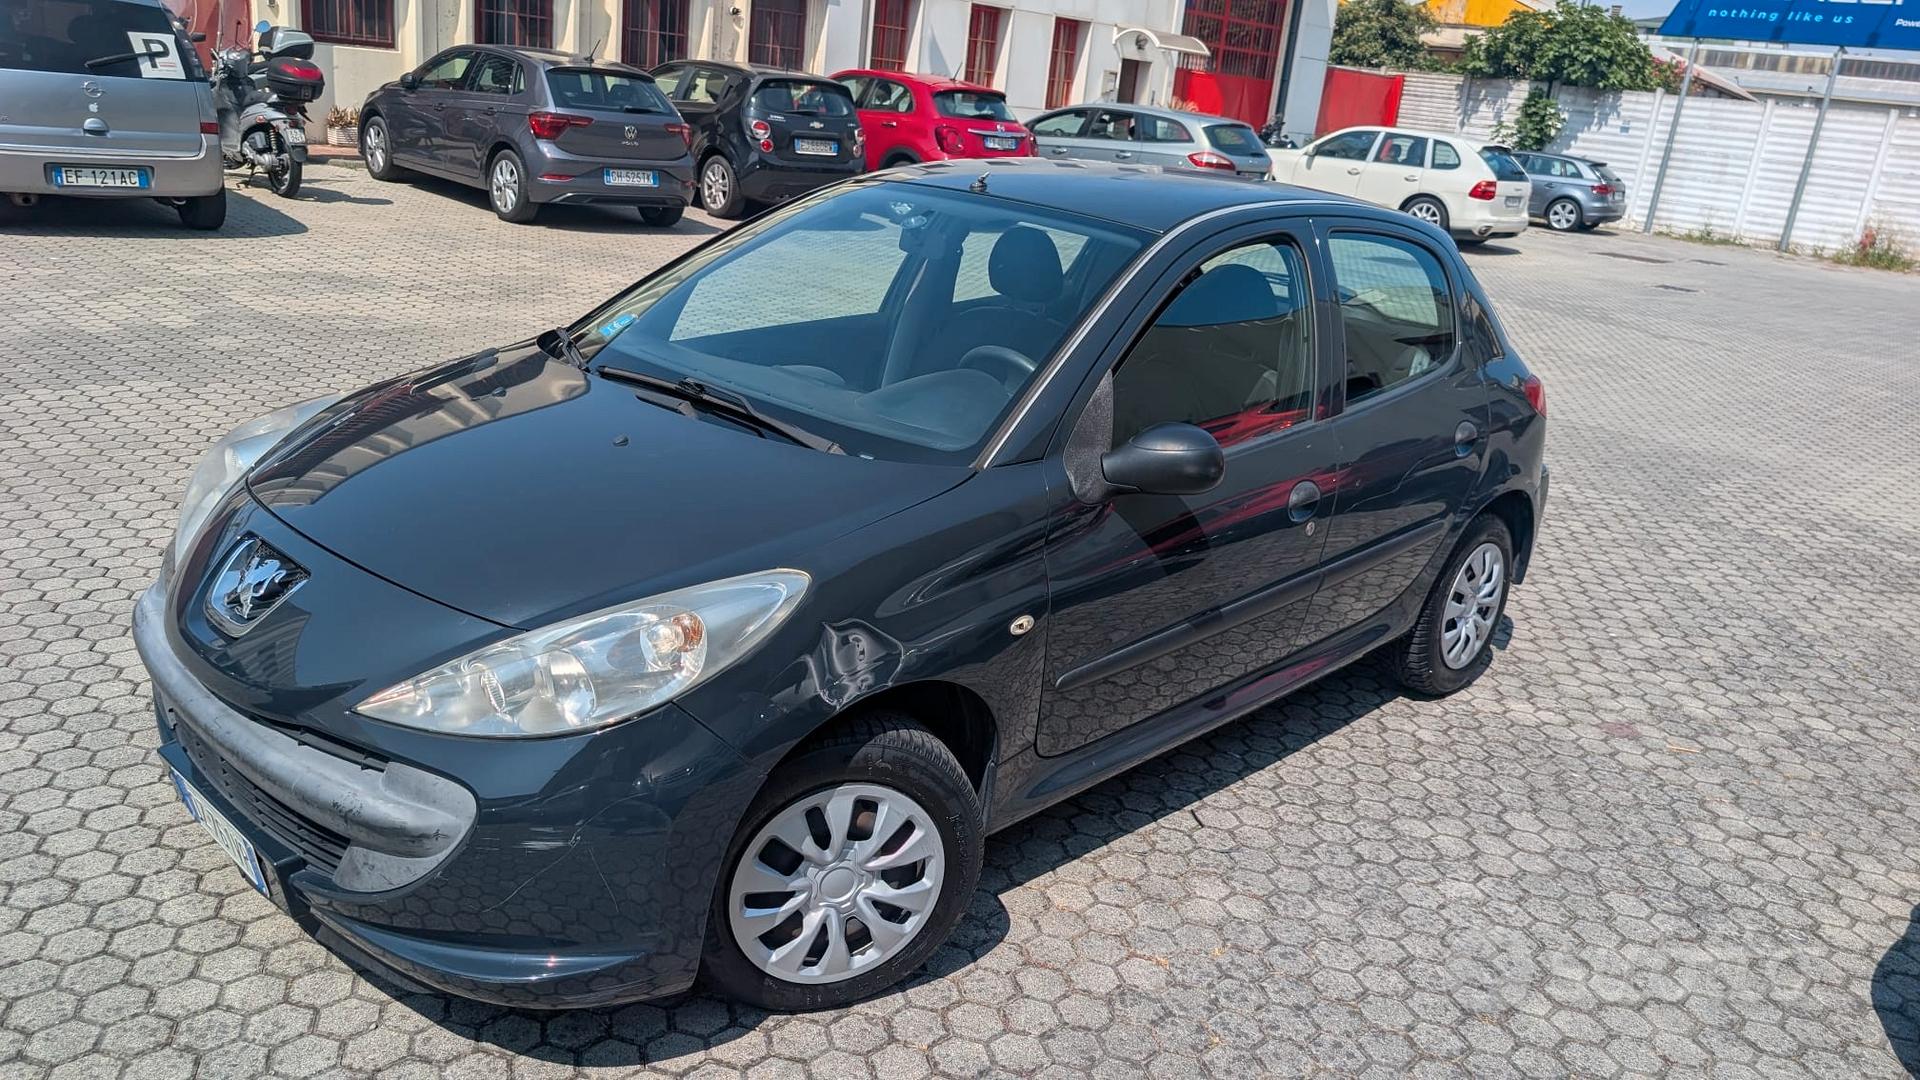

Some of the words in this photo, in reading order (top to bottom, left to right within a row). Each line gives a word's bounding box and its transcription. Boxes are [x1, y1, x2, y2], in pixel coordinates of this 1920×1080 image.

[1708, 9, 1779, 22] nothing
[1787, 11, 1824, 22] like
[1832, 15, 1854, 24] us
[141, 38, 170, 69] P
[64, 169, 82, 184] EF
[92, 170, 138, 185] 121AC
